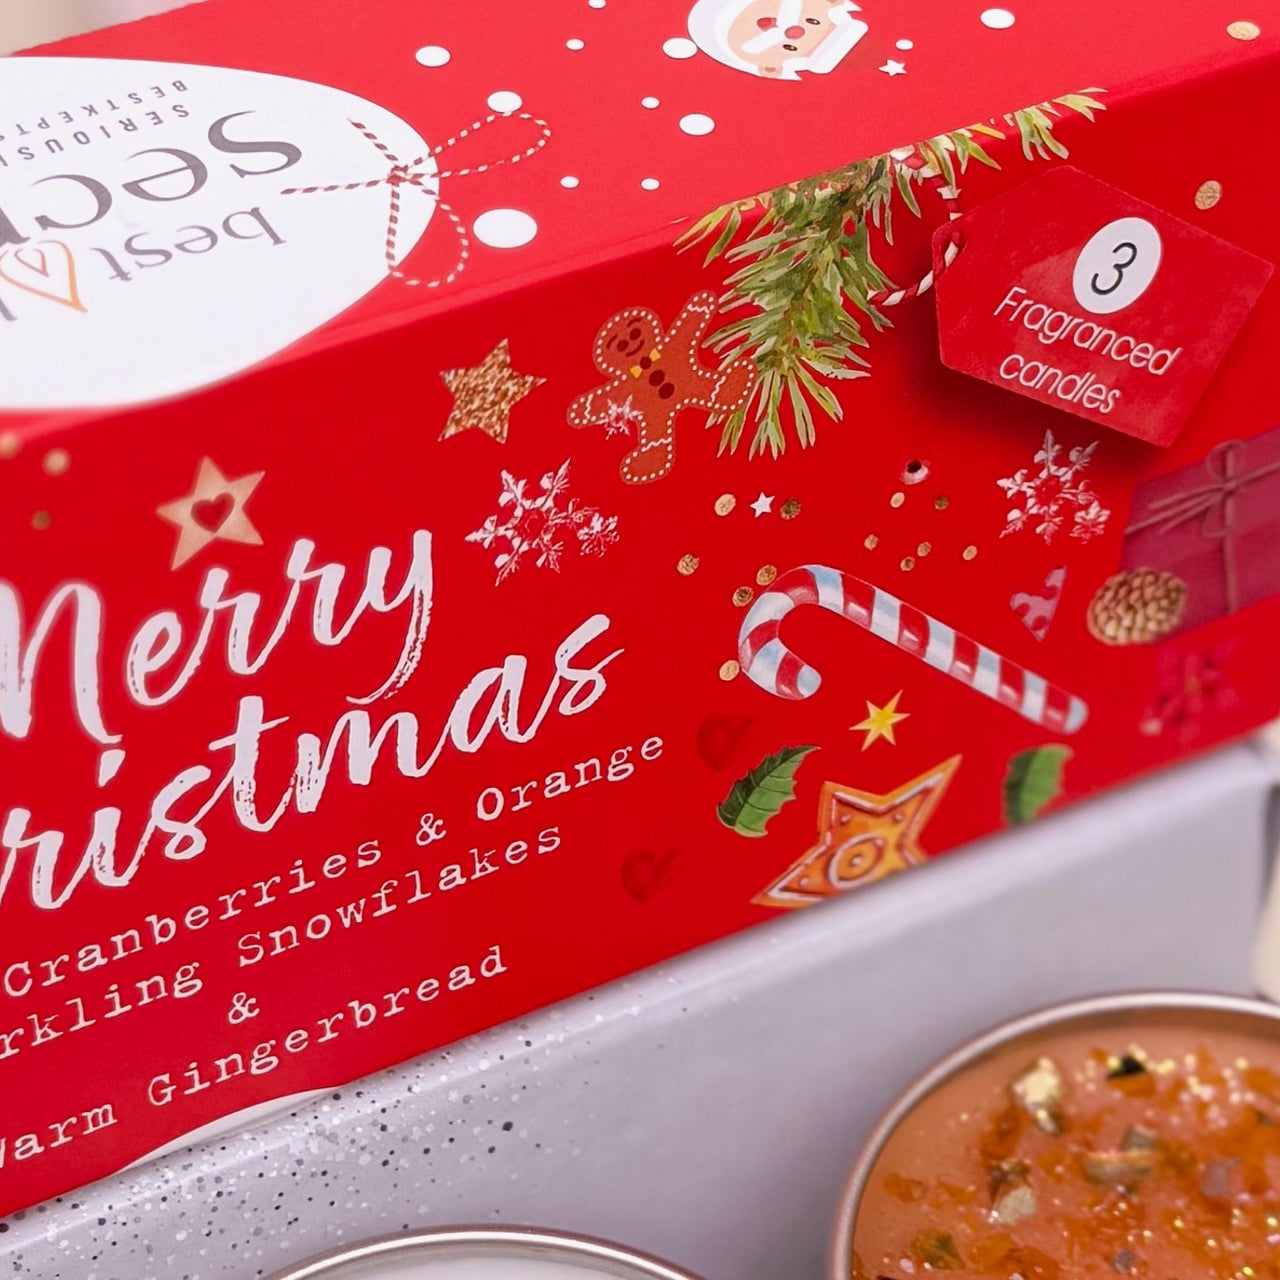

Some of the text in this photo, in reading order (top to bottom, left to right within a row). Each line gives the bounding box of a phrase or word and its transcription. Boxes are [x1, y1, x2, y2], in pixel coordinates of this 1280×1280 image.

[88, 206, 288, 282] best
[1090, 241, 1138, 296] 3
[992, 285, 1183, 376] Fragranced
[999, 353, 1122, 414] candles
[2, 835, 384, 999] Cranberries
[414, 811, 448, 846] &
[475, 733, 666, 823] Orange
[237, 824, 563, 969] Snowflakes
[146, 945, 508, 1108] Gingerbread
[227, 991, 261, 1025] &
